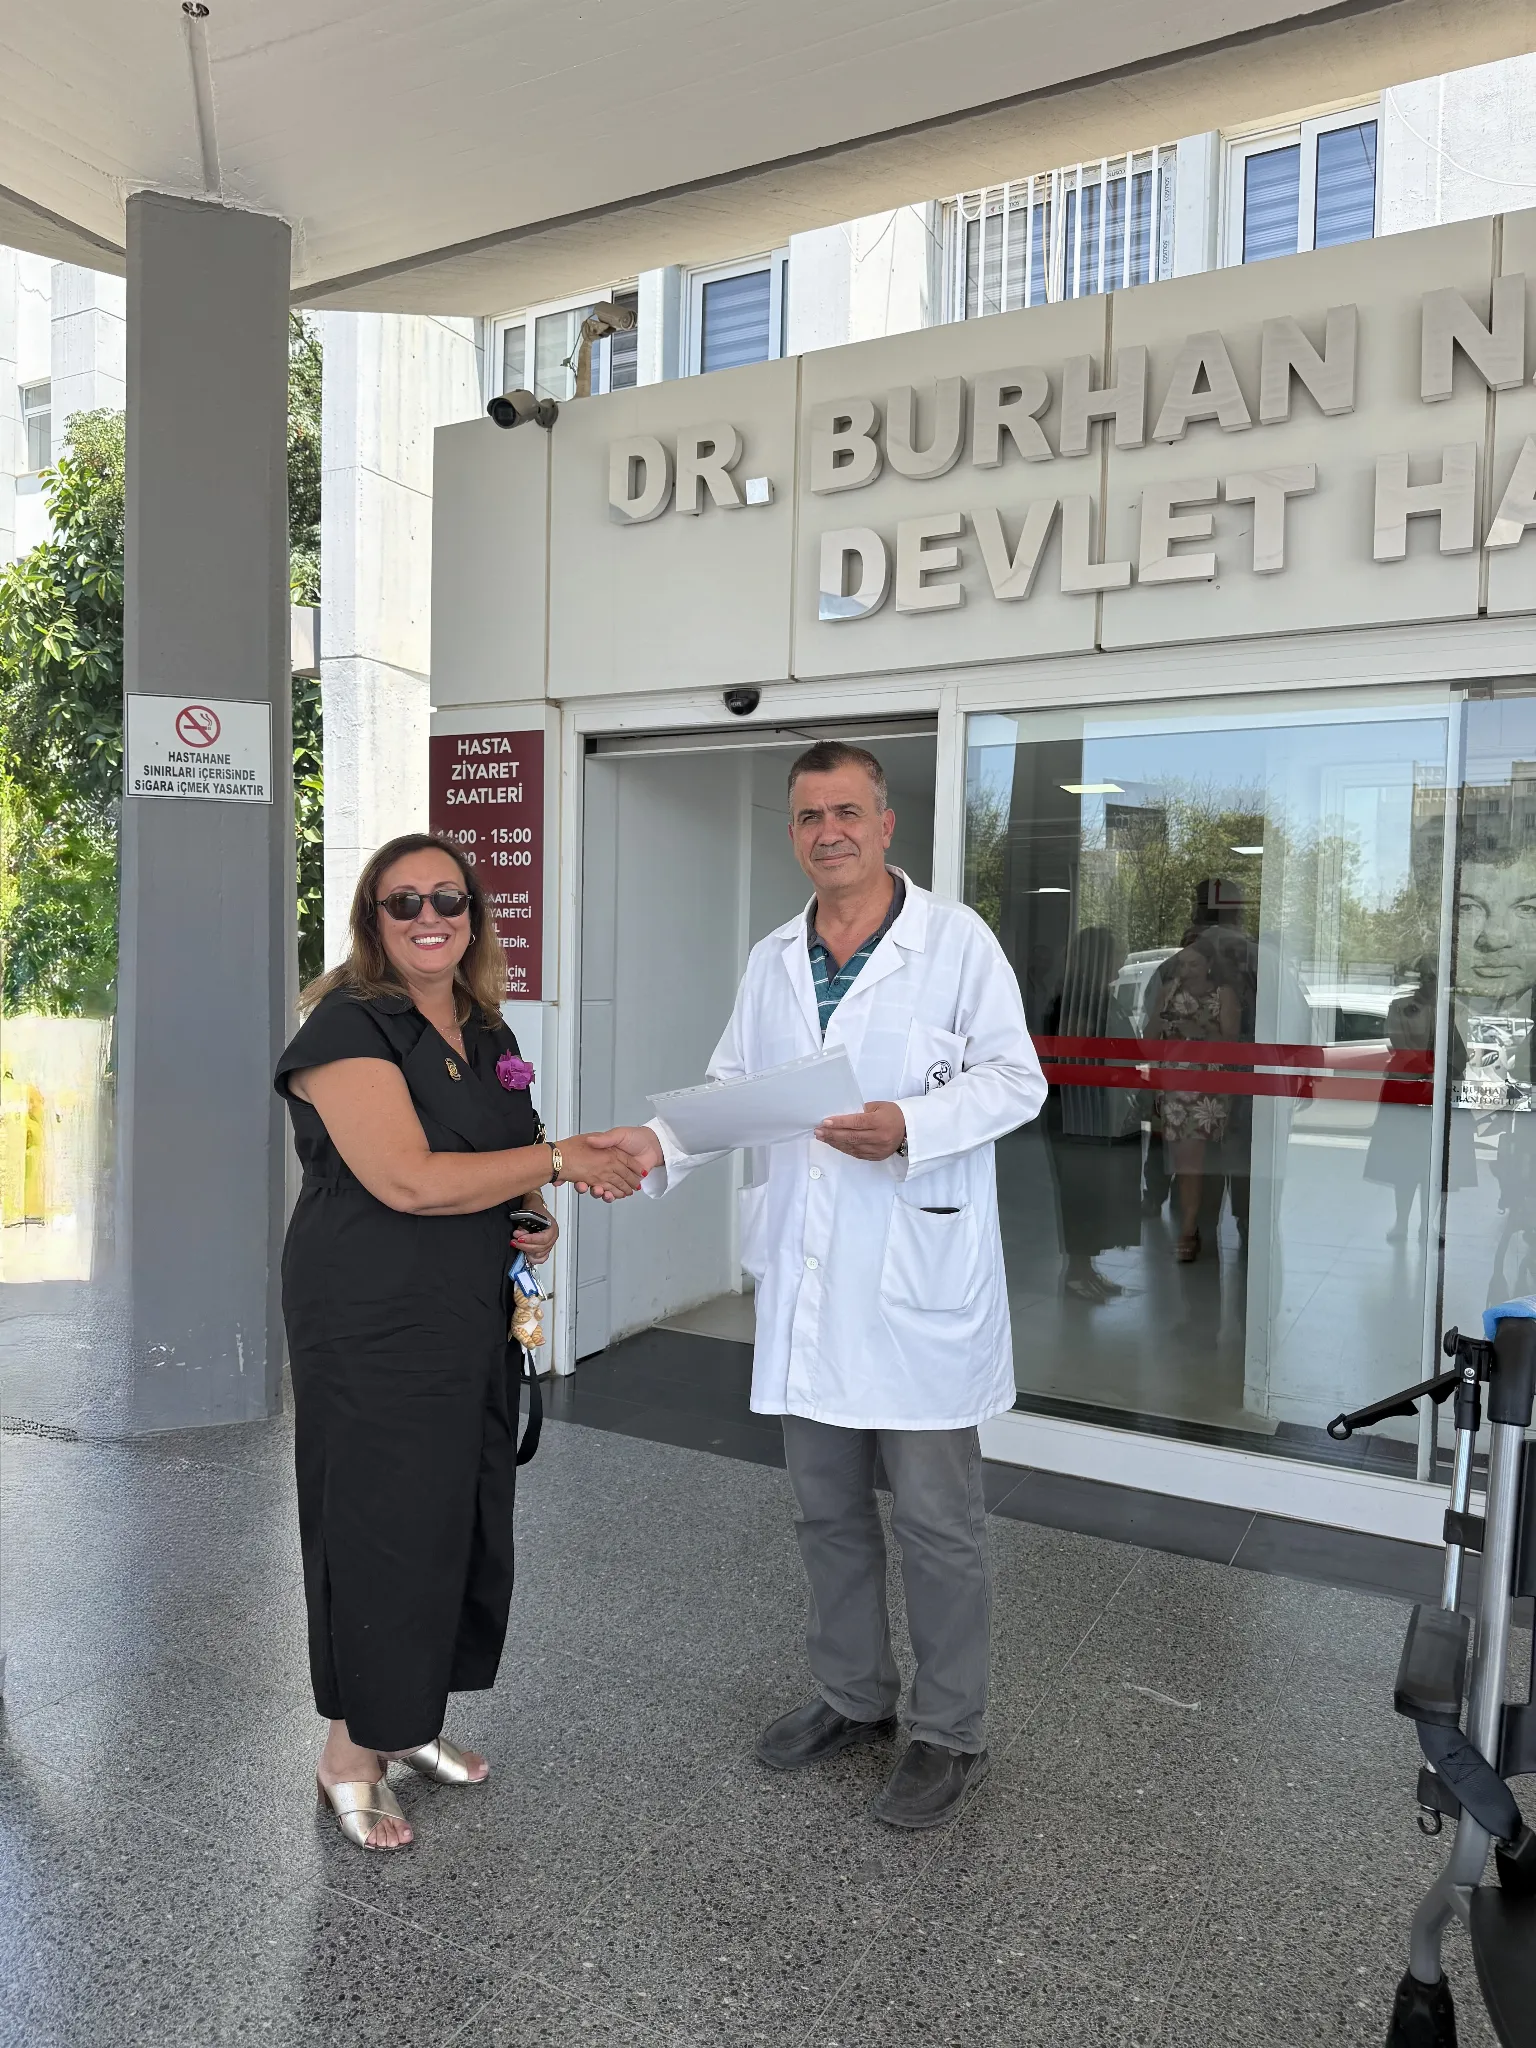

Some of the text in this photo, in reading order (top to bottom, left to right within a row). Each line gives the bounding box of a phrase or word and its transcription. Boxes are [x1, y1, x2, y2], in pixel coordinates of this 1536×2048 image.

[608, 272, 1536, 525] DR. BURHAN N
[819, 463, 1317, 623] DEVLET
[457, 737, 512, 756] HASTA
[168, 751, 231, 765] HASTAHANE
[143, 765, 196, 779] SINIRLARI
[451, 760, 520, 781] ZİYARET
[213, 783, 264, 796] YASAKTIR
[446, 783, 523, 805] SAATLERİ
[490, 828, 532, 844] 15:00
[490, 851, 532, 867] 18:00
